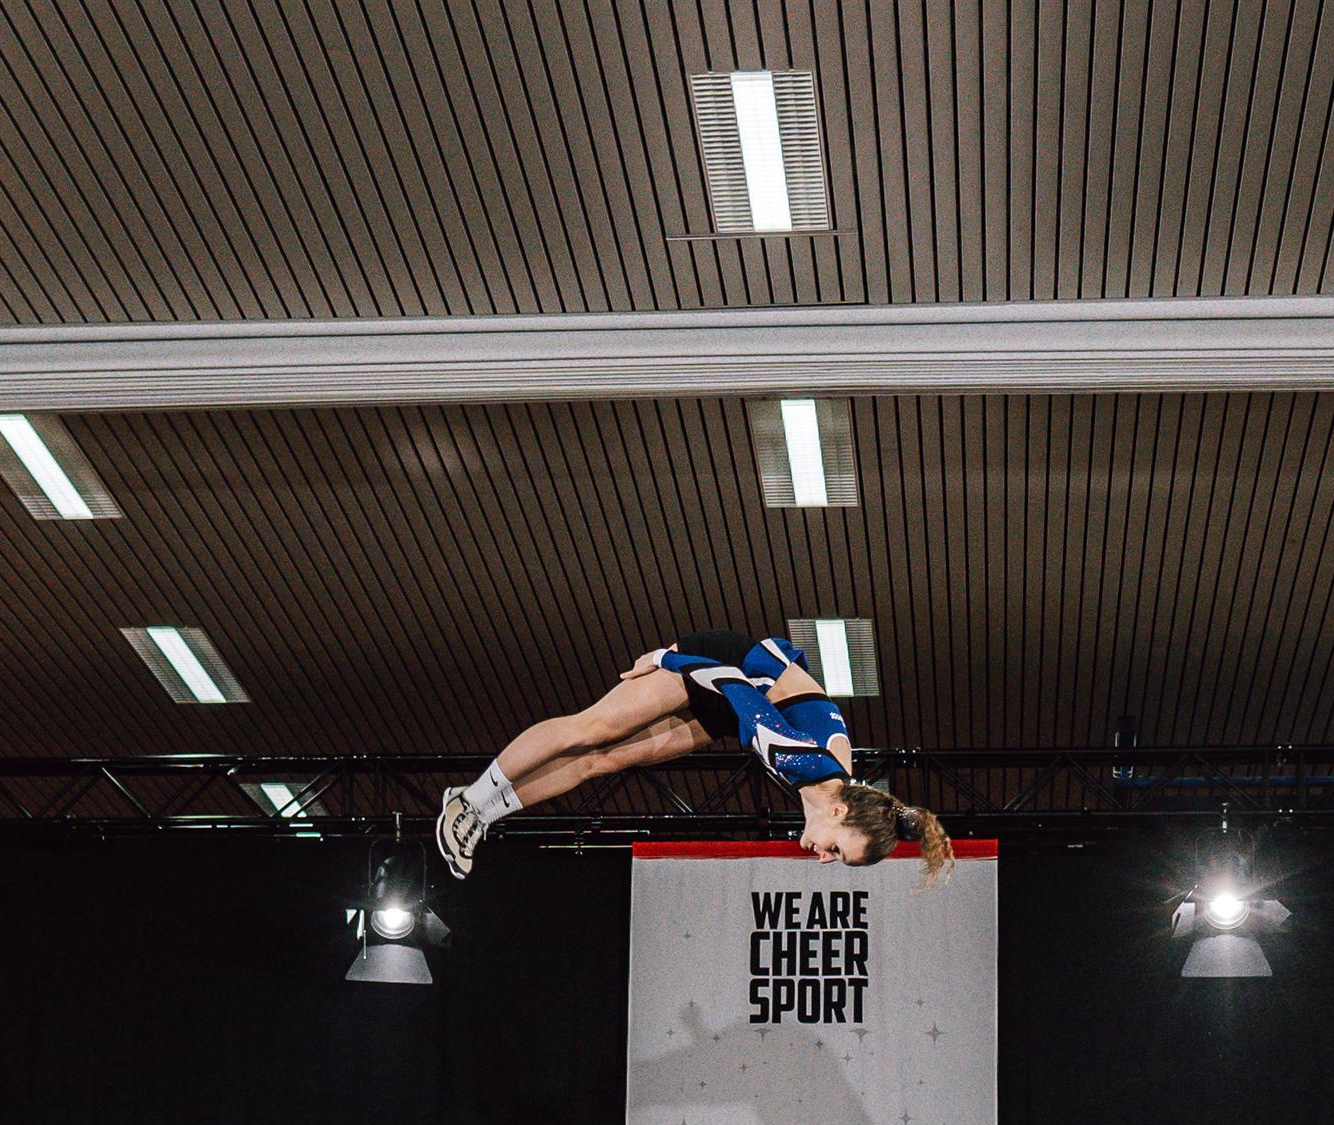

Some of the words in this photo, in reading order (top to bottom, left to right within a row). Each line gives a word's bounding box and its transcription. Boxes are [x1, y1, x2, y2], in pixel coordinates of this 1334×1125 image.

[751, 892, 802, 929] WE
[806, 891, 868, 929] ARE
[750, 931, 868, 976] CHEER
[749, 978, 868, 1024] SPORT
